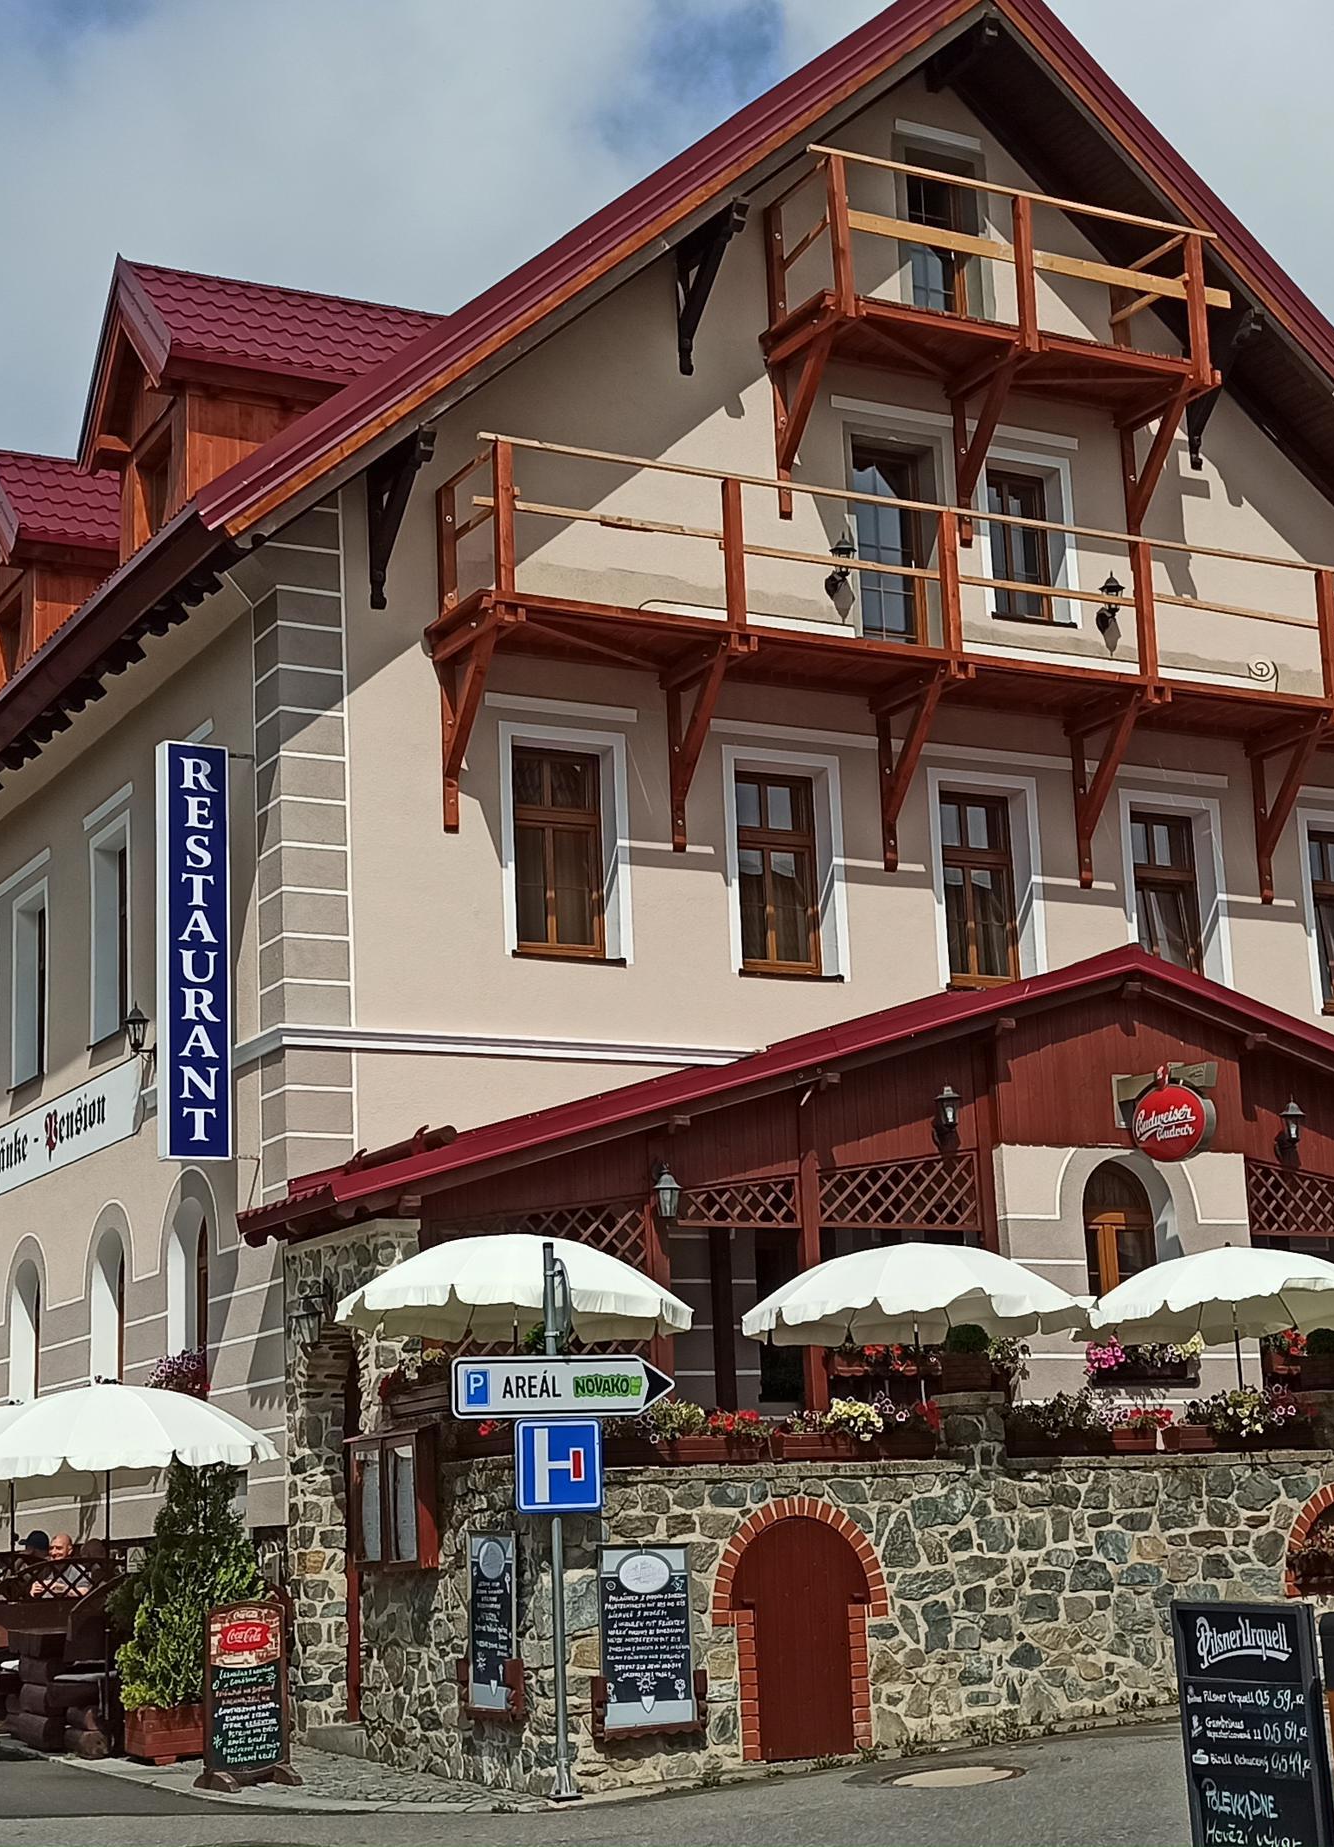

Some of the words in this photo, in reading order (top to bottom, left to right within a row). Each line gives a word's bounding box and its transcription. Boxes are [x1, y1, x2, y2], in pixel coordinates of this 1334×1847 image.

[178, 756, 221, 1142] RESTAURANT
[44, 1093, 107, 1162] Pension
[1135, 1103, 1197, 1139] Budweiser
[470, 1374, 484, 1395] P
[502, 1370, 562, 1398] AREÁL
[574, 1374, 630, 1397] NOVAKO
[227, 1626, 263, 1644] Coca-Cola
[1196, 1616, 1242, 1669] Pilsner
[1238, 1616, 1293, 1661] Urquell
[1203, 1690, 1227, 1703] Pilsner
